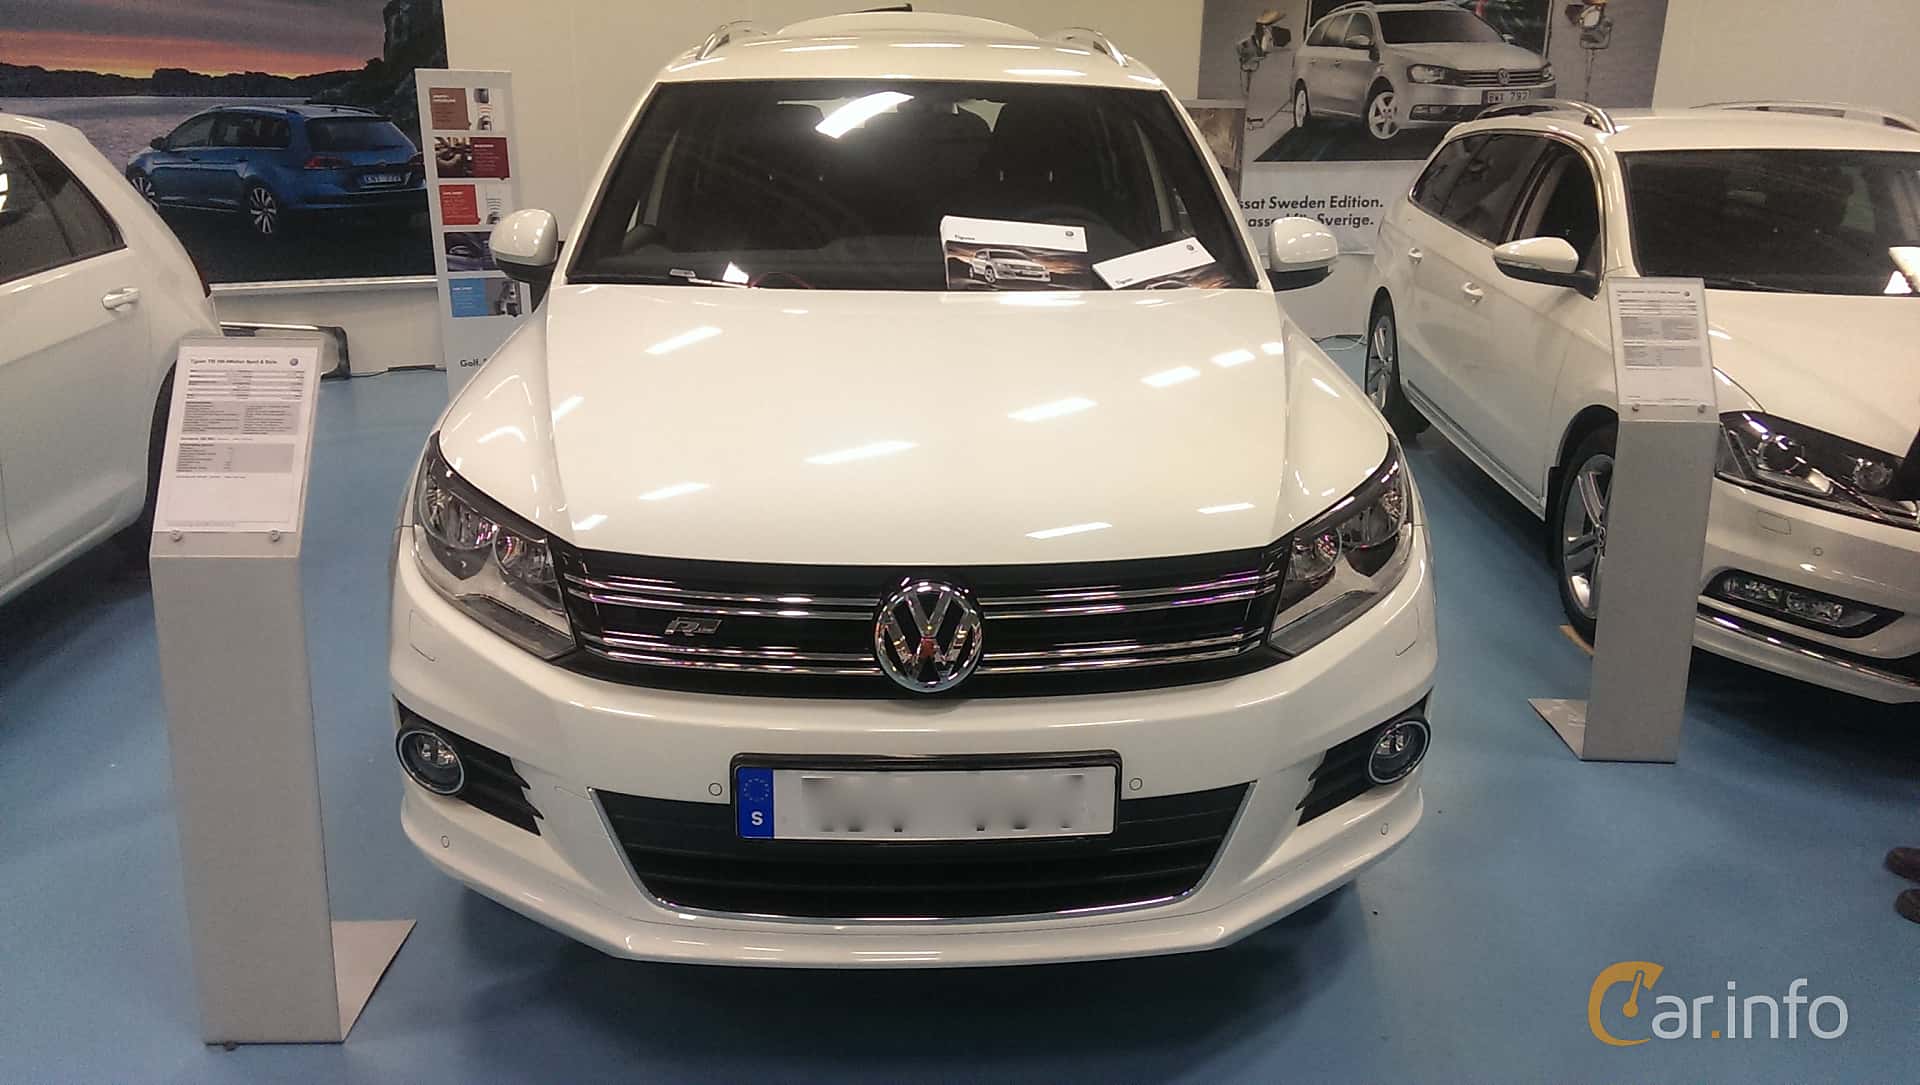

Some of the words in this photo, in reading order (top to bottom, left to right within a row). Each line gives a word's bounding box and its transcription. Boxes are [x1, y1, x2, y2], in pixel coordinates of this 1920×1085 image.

[1238, 197, 1265, 209] ssat
[1269, 195, 1326, 209] Sweden
[1330, 195, 1384, 209] Edition.
[1317, 213, 1374, 229] Sverige.
[751, 811, 763, 826] S
